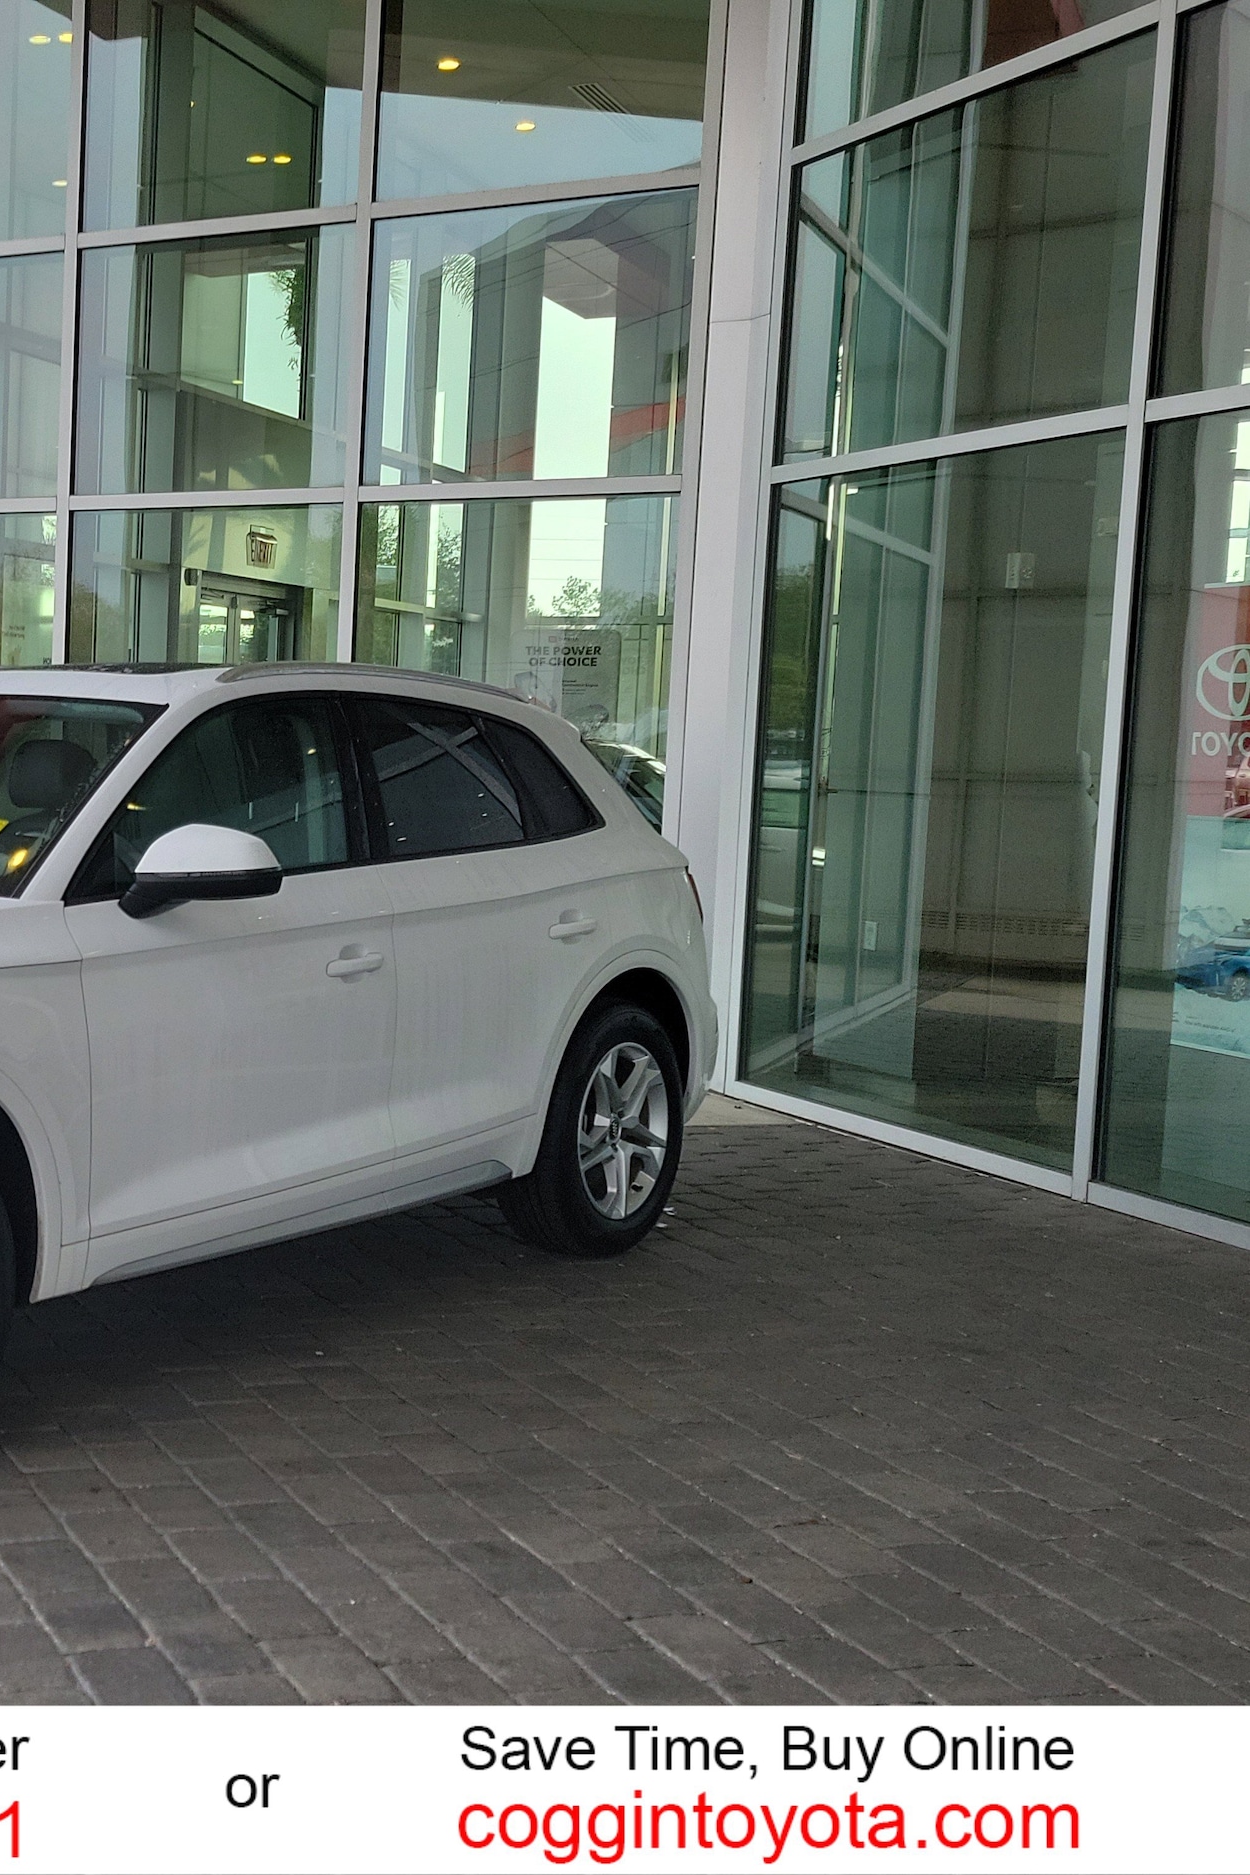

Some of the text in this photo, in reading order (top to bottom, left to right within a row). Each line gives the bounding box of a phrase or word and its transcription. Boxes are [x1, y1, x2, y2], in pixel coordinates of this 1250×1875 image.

[526, 645, 602, 656] THE POWER
[529, 657, 598, 667] OF CHOICE
